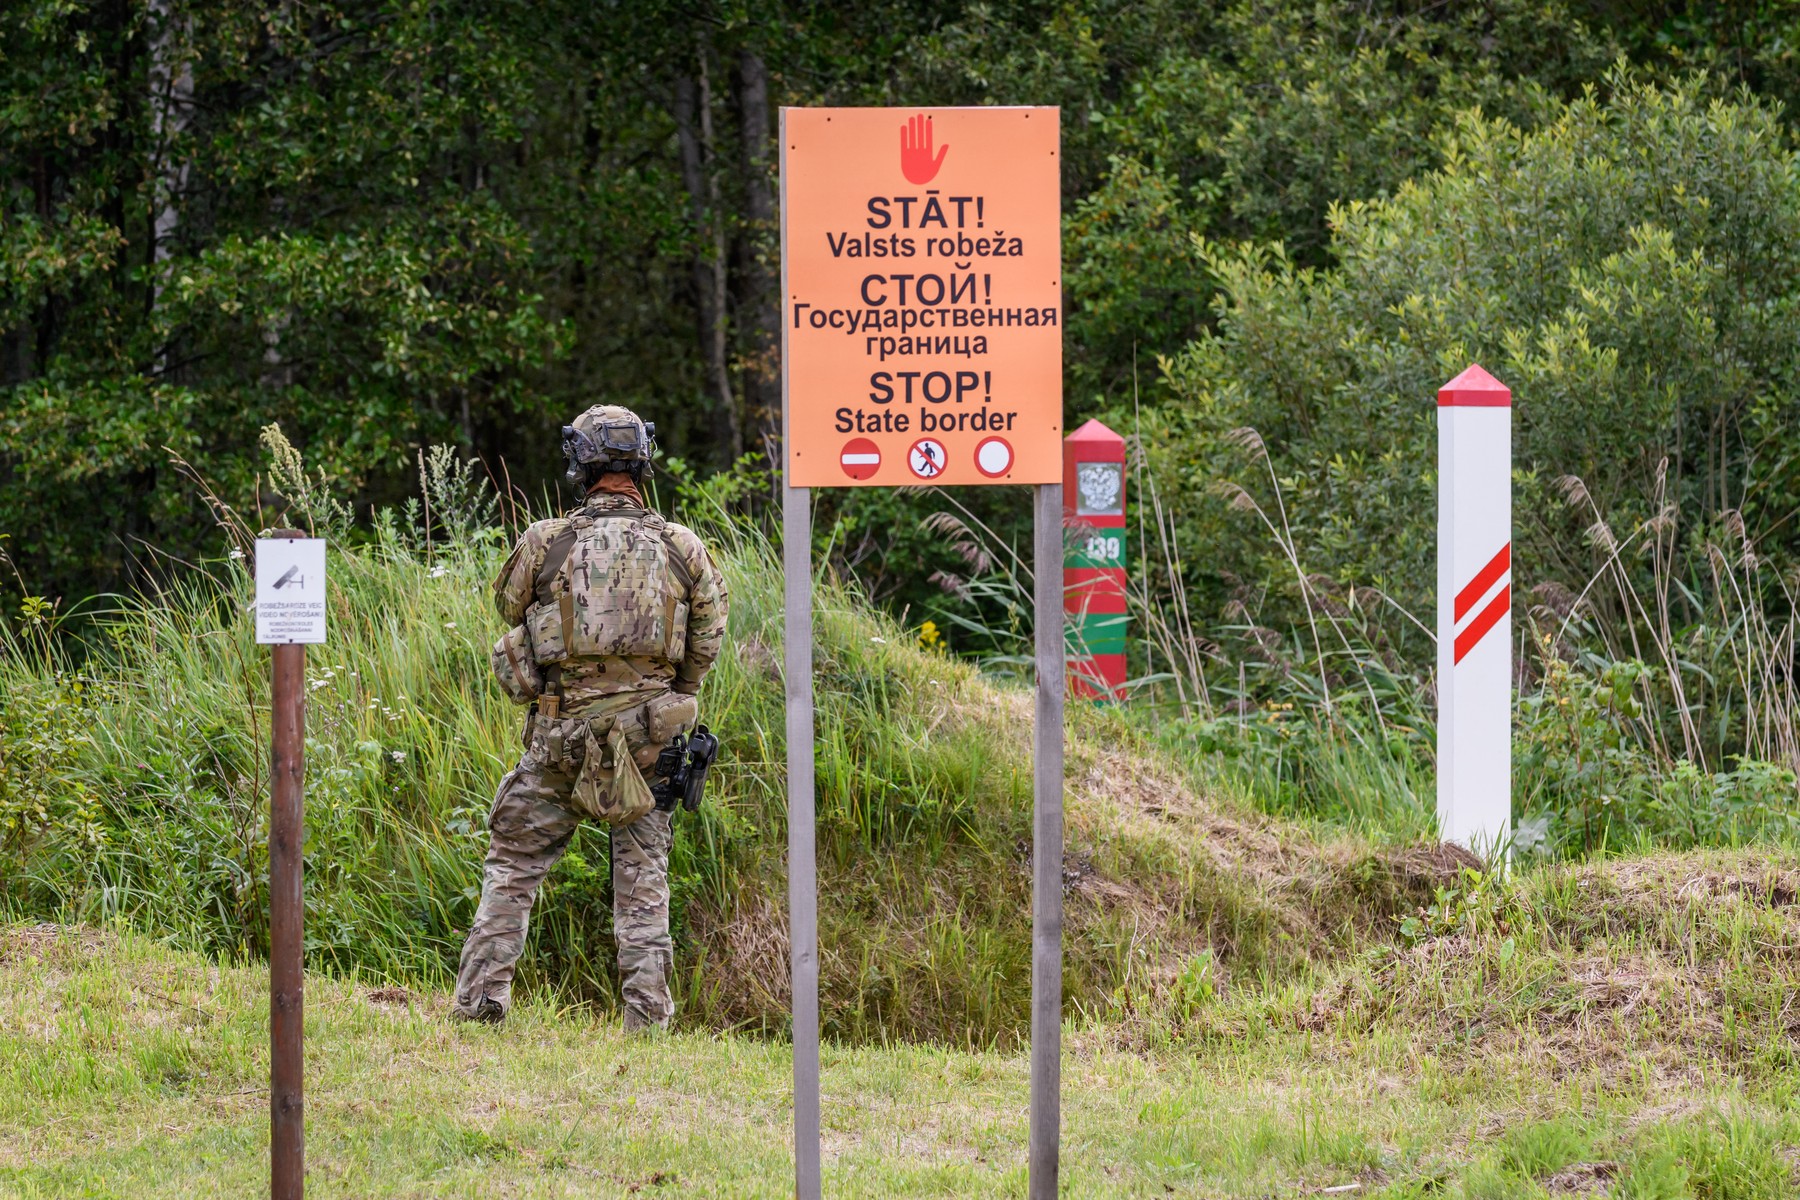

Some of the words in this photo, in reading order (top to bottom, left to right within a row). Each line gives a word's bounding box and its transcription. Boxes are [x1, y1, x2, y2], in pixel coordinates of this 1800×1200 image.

[867, 190, 984, 229] STĀT!
[826, 232, 916, 257] Valsts
[927, 231, 1023, 256] robeža
[861, 262, 991, 306] СТОЙ!
[794, 303, 1057, 335] Государственная
[866, 336, 988, 361] граница
[869, 371, 991, 404] STOP!
[835, 408, 910, 433] State
[920, 407, 1017, 432] border
